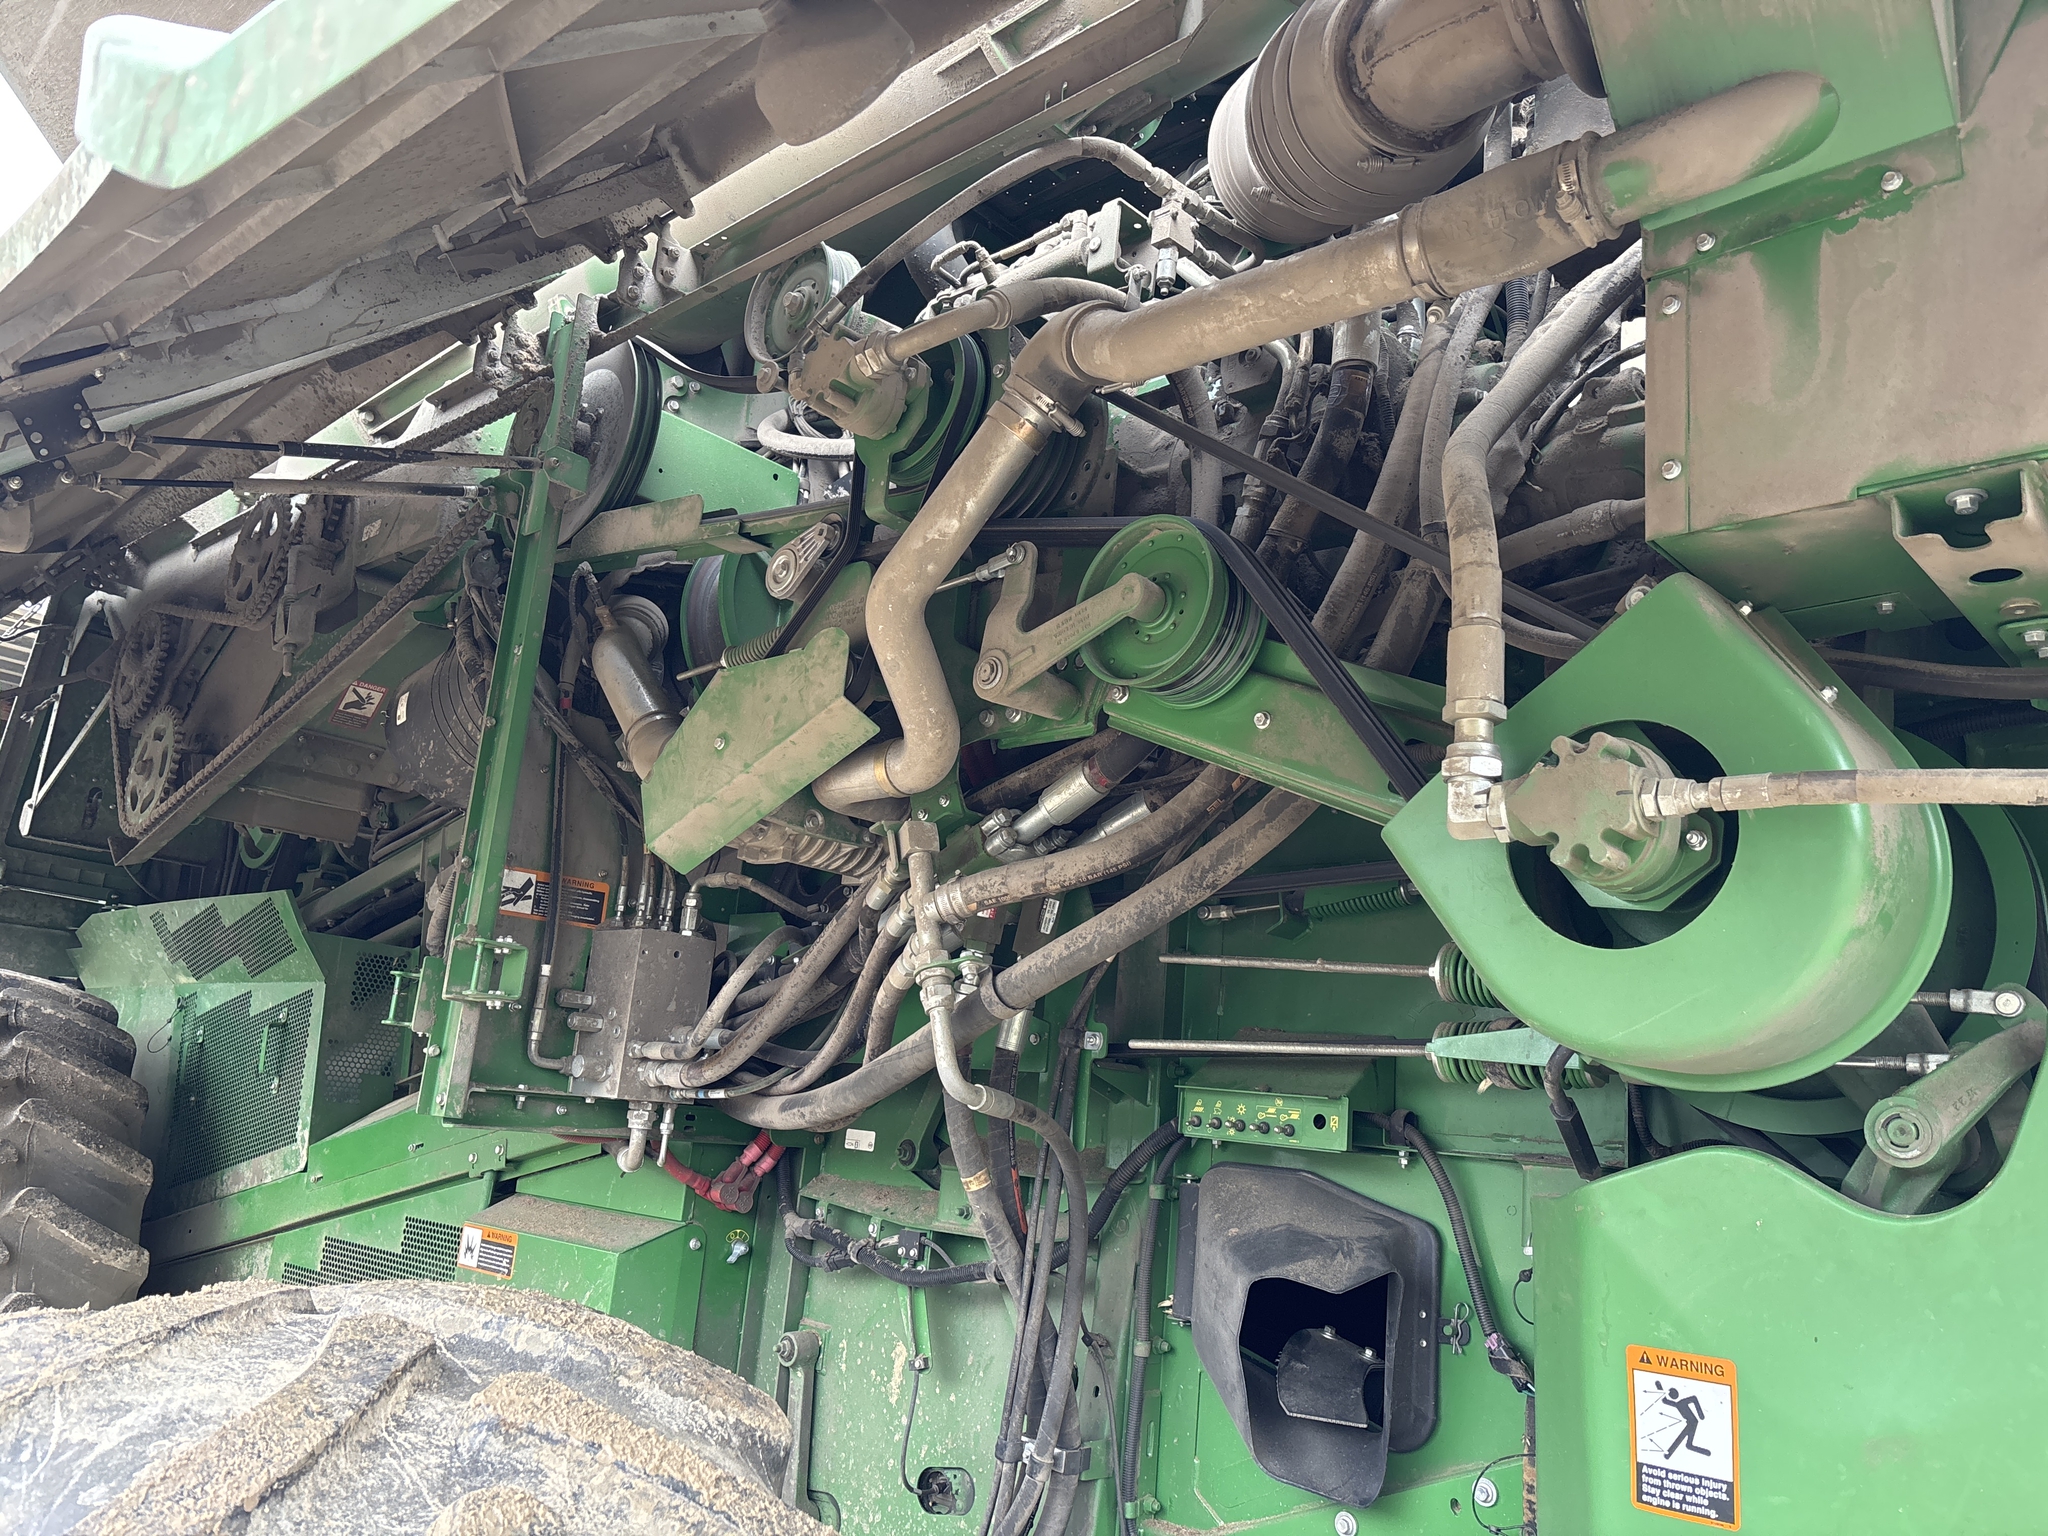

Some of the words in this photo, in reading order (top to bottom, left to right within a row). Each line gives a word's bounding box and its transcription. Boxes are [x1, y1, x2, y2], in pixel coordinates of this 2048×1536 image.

[359, 682, 387, 693] DANGER
[562, 877, 595, 889] WARNING
[491, 1231, 513, 1243] WARNING
[1656, 1354, 1725, 1377] WARNING
[1642, 1465, 1666, 1479] Avoid
[1668, 1471, 1700, 1485] serious
[1702, 1476, 1728, 1492] injury
[1642, 1475, 1662, 1486] from
[1663, 1479, 1693, 1493] thrown
[1695, 1484, 1730, 1501] objects.
[1642, 1485, 1661, 1499] Stay
[1663, 1489, 1684, 1501] clear
[1685, 1493, 1709, 1506] while
[1642, 1495, 1670, 1509] engine
[1672, 1499, 1681, 1510] is
[1682, 1503, 1718, 1519] running.
